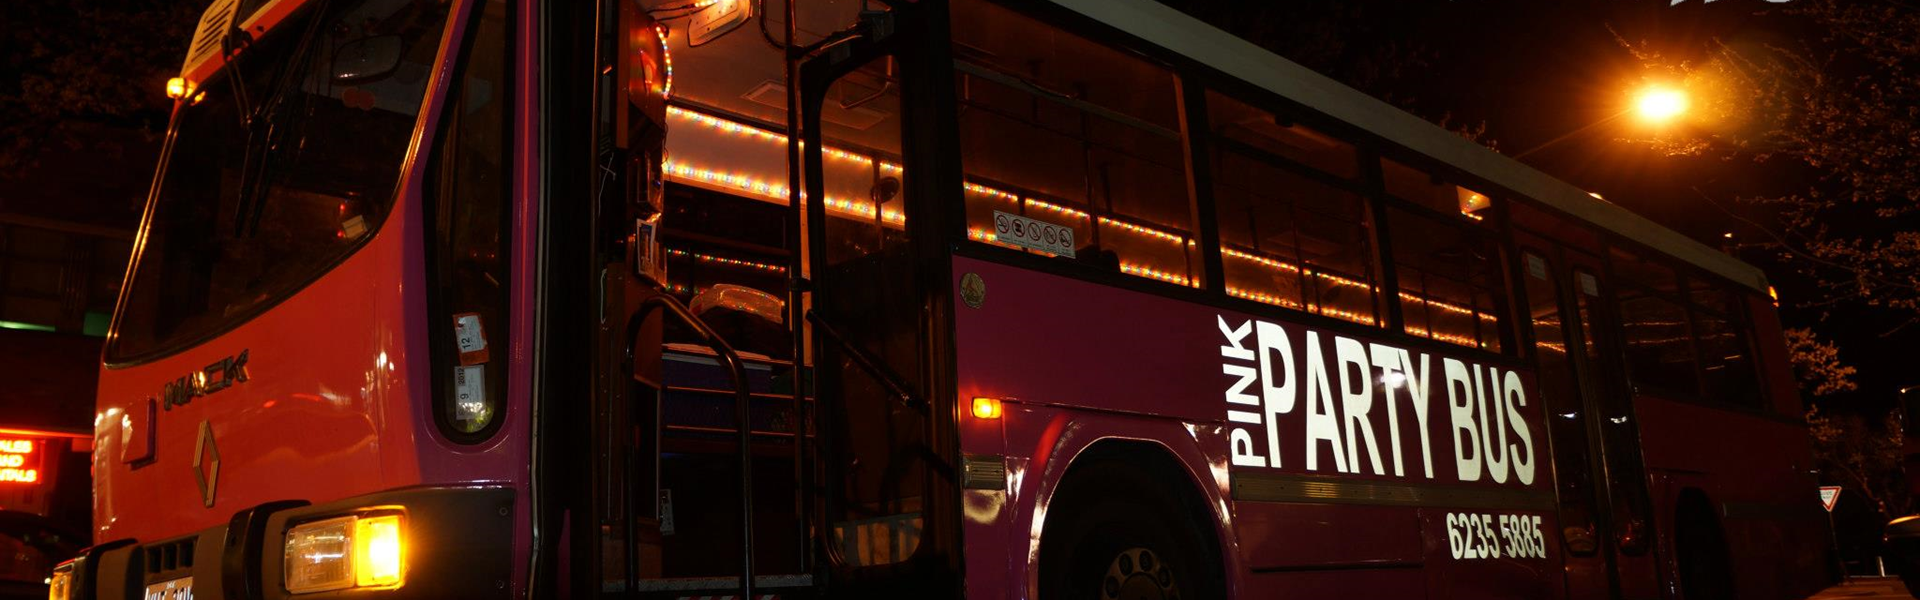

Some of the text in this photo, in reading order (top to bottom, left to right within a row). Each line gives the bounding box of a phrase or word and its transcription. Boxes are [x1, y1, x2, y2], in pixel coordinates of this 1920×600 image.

[461, 337, 471, 349] 12
[163, 348, 250, 412] MACK
[1217, 313, 1267, 468] PINK
[1256, 320, 1536, 487] PARTY BUS
[0, 453, 24, 468] ND
[1446, 512, 1547, 560] 6235 5885
